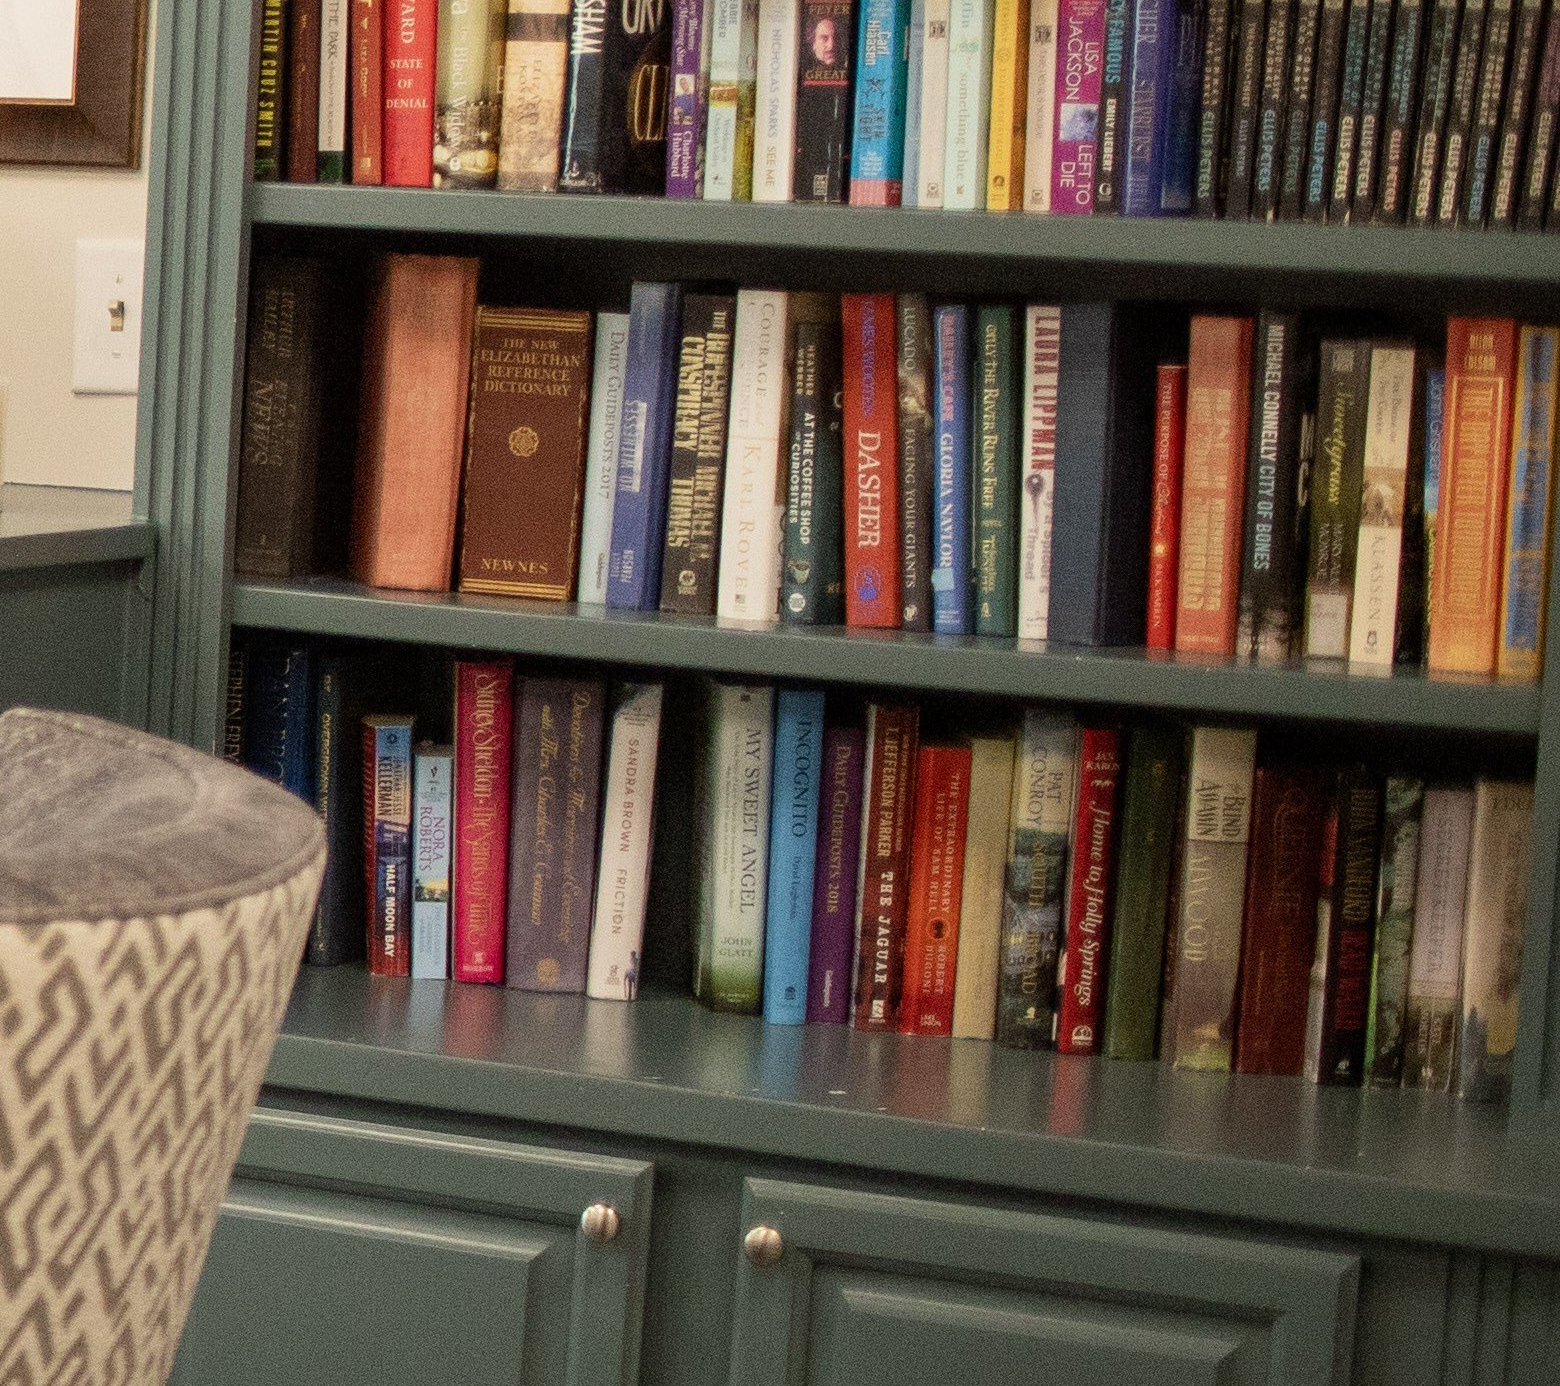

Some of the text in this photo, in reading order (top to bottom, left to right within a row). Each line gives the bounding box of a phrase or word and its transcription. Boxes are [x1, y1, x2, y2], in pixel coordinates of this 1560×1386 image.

[385, 97, 429, 109] DENIAL
[389, 58, 424, 70] STATE
[397, 79, 414, 89] OF
[1064, 16, 1083, 101] JACKSON
[1084, 41, 1100, 76] LISA
[1059, 161, 1076, 189] DIE
[1075, 144, 1093, 206] LEFT TO
[1333, 115, 1354, 199] ELLIS PETERS
[799, 412, 816, 545] AT THE COFFEE SHOP
[856, 430, 881, 550] DASHER
[1253, 324, 1285, 571] MICHAEL CONNELLY CITY OF BONES
[938, 432, 955, 568] GLORIA NAYLOR
[481, 557, 549, 576] NEWNES
[739, 728, 761, 914] MY SWEET ANGEL
[790, 720, 813, 839] INCOGNITO
[610, 738, 640, 935] SANDRA BROWN FRICTION
[383, 864, 397, 958] HALF MOON BAY
[873, 870, 894, 984] THE JAGUAR
